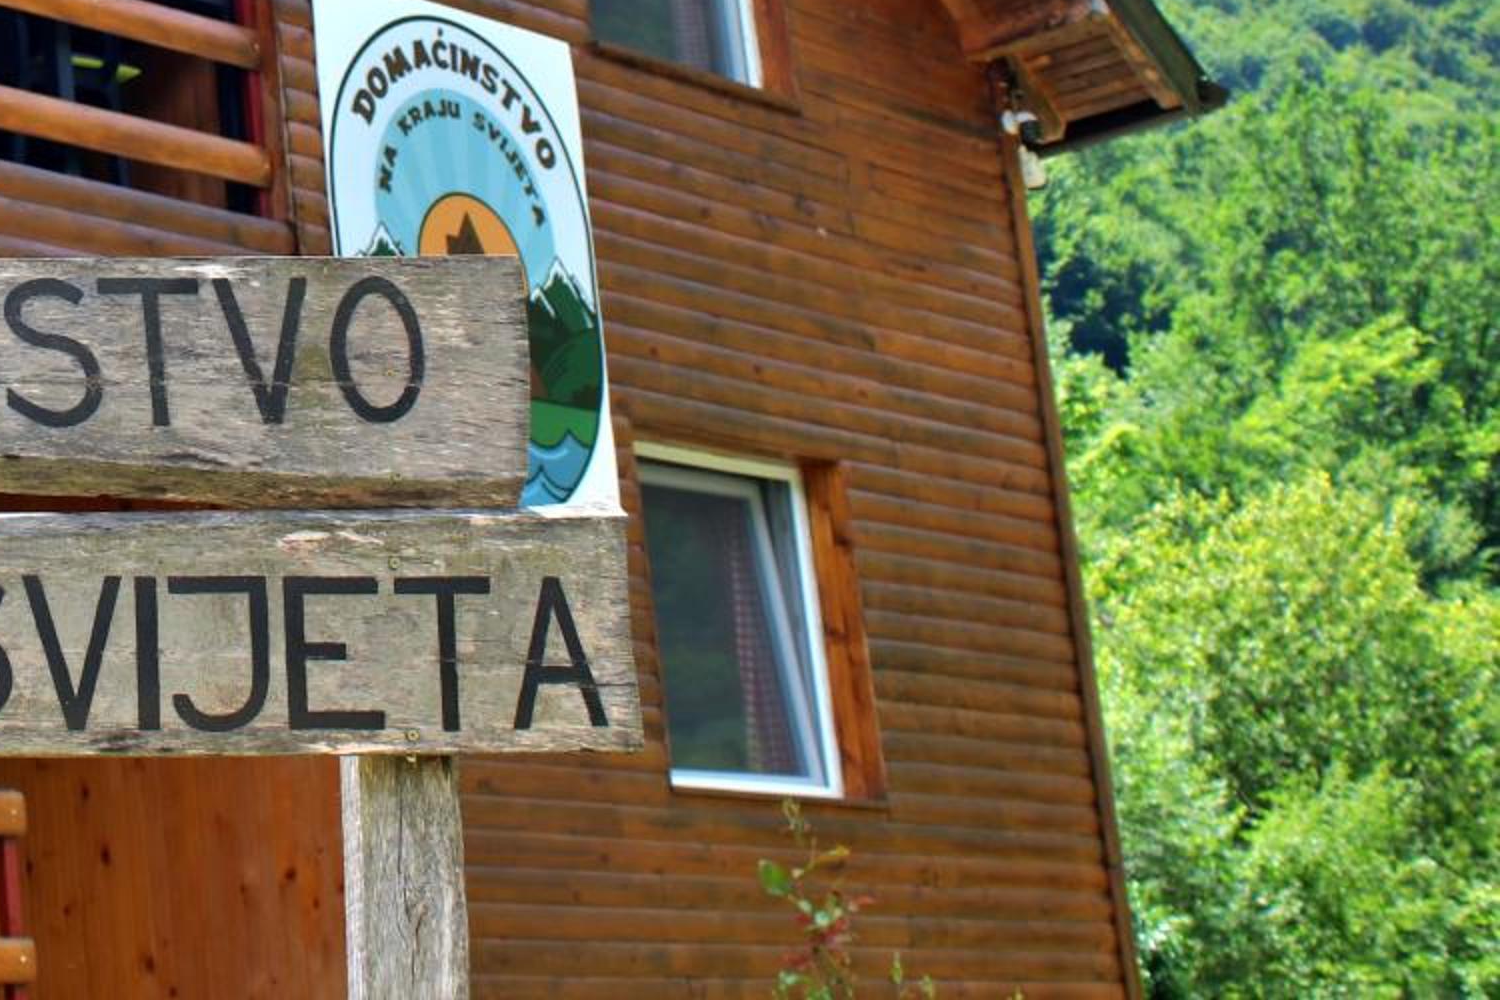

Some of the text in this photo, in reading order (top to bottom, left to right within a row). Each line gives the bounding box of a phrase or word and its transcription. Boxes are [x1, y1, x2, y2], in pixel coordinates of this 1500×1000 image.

[378, 98, 546, 228] NA KRAJU SVIJETA
